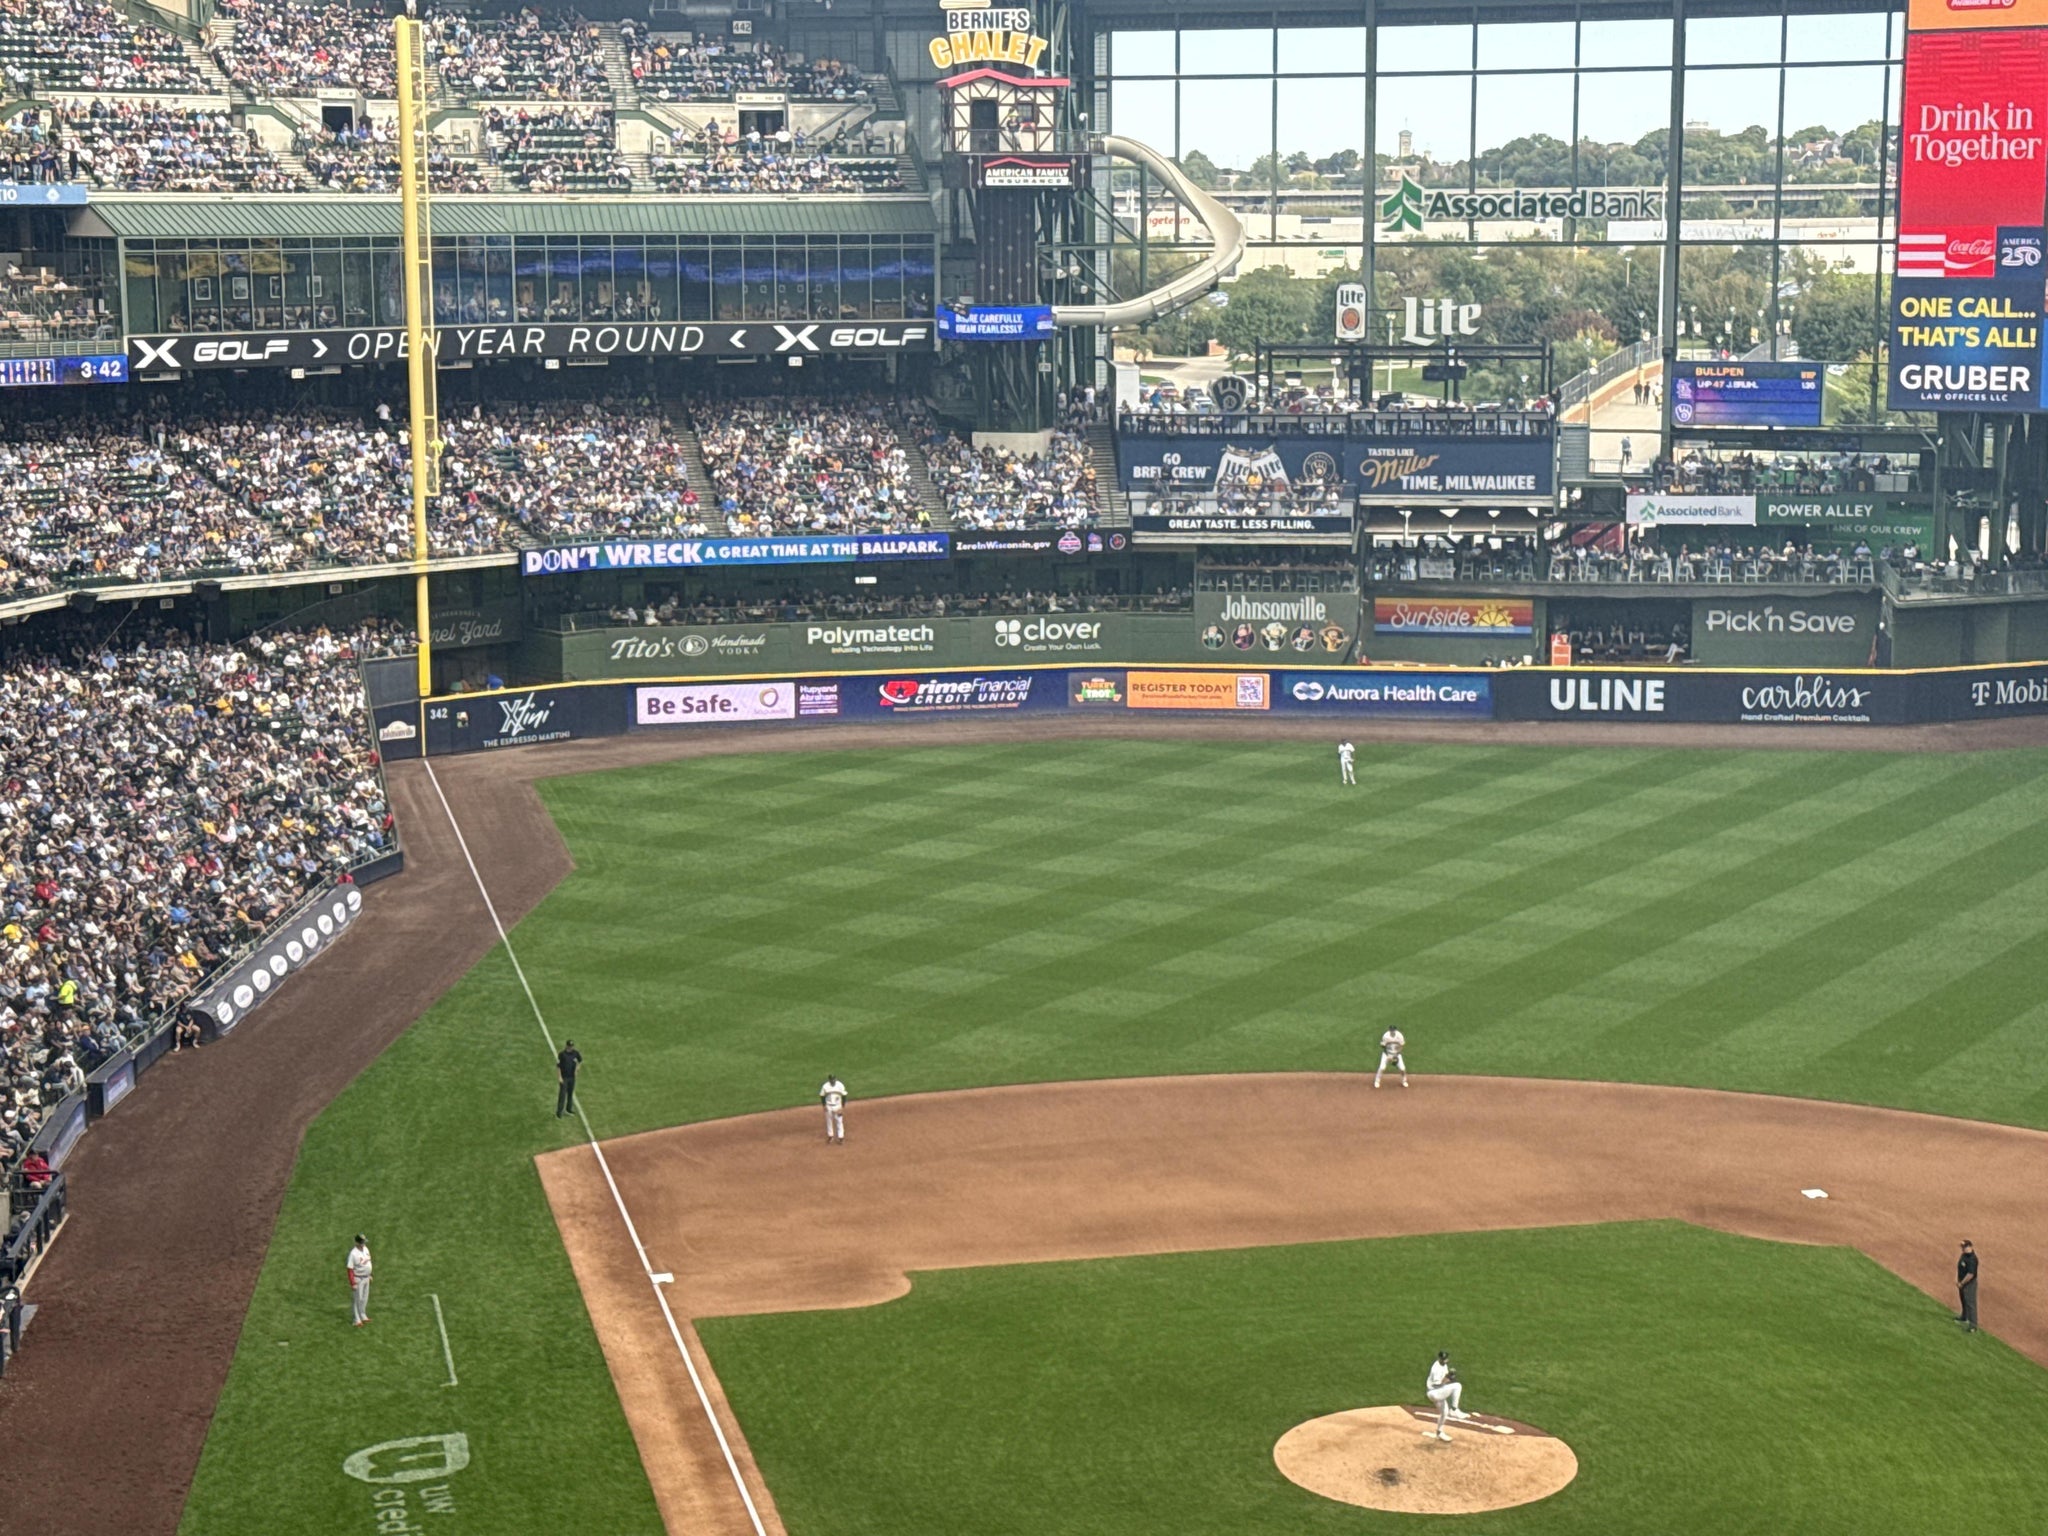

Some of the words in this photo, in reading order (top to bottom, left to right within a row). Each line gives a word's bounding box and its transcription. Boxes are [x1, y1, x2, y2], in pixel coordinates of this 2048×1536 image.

[733, 23, 751, 32] 442
[949, 10, 1028, 30] BERNIE'S
[929, 31, 1048, 69] CHALET
[1920, 102, 2000, 132] Drink
[2006, 102, 2033, 130] in
[1910, 132, 2042, 167] Together
[986, 168, 1033, 176] AMERICAN
[1036, 168, 1069, 176] FAMILY
[1948, 239, 1992, 255] Coca-Cola
[2001, 246, 2041, 266] 250
[1339, 289, 1364, 306] Lite
[1900, 297, 1953, 318] ONE
[1958, 297, 2036, 318] CALL...
[1401, 296, 1482, 346] Lite
[456, 328, 546, 355] YEAR
[568, 326, 704, 353] ROUND
[773, 325, 820, 351] X
[830, 328, 928, 347] GOLF
[1898, 327, 1980, 347] THAT'S
[1985, 327, 2037, 348] ALL!
[133, 339, 182, 369] X
[193, 339, 290, 362] GOLF
[80, 360, 121, 378] 3:42
[1695, 367, 1745, 377] BULLPEN
[1900, 364, 2030, 391] GRUBER
[1944, 393, 1987, 401] OFFICES
[1163, 452, 1181, 465] GO
[1368, 448, 1395, 457] TASTES
[1397, 448, 1415, 457] LIKE
[1360, 455, 1440, 488] Miller
[1401, 475, 1443, 491] TIME,
[1445, 475, 1536, 490] MILWAUKEE
[1768, 505, 1821, 517] POWER
[1825, 505, 1874, 517] ALLEY
[1169, 519, 1202, 529] GREAT
[1204, 519, 1240, 529] TASTE.
[1242, 519, 1268, 529] LESS
[1270, 519, 1315, 530] FILLING.
[1854, 525, 1868, 533] OF
[1870, 525, 1891, 534] OUR
[1893, 526, 1921, 535] CREW
[956, 540, 1051, 551] ZeroInWisconsin.gov
[526, 546, 599, 573] DON'T
[604, 542, 703, 566] WRECK
[704, 547, 715, 559] A
[719, 545, 768, 558] GREAT
[771, 544, 807, 557] TIME
[810, 543, 830, 556] AT
[831, 542, 859, 555] THE
[862, 541, 943, 554] BALLPARK.
[1221, 595, 1326, 621] Johnsonville
[1390, 602, 1470, 630] Surfside
[1023, 617, 1101, 641] clover
[1706, 610, 1762, 632] Pick
[1789, 611, 1855, 633] Save
[459, 619, 502, 645] Yard
[712, 633, 766, 647] Handmade
[807, 626, 934, 647] Polymatech
[611, 636, 675, 660] Tito's
[719, 647, 759, 655] VODKA
[915, 694, 971, 704] CREDIT
[978, 691, 1028, 702] UNION
[1132, 683, 1187, 692] REGISTER
[1190, 684, 1233, 693] TODAY!
[1326, 684, 1380, 700] Aurora
[1384, 685, 1436, 701] Health
[1438, 686, 1477, 701] Care
[1550, 679, 1665, 711] ULINE
[1742, 676, 1872, 710] carbliss
[430, 708, 448, 719] 342
[647, 698, 675, 715] Be
[682, 694, 738, 714] Safe.
[1795, 714, 1832, 722] Premium
[1832, 714, 1871, 722] Cocktails
[483, 739, 499, 748] THE
[500, 736, 538, 746] ESPRESSO
[539, 731, 570, 742] MARTINI
